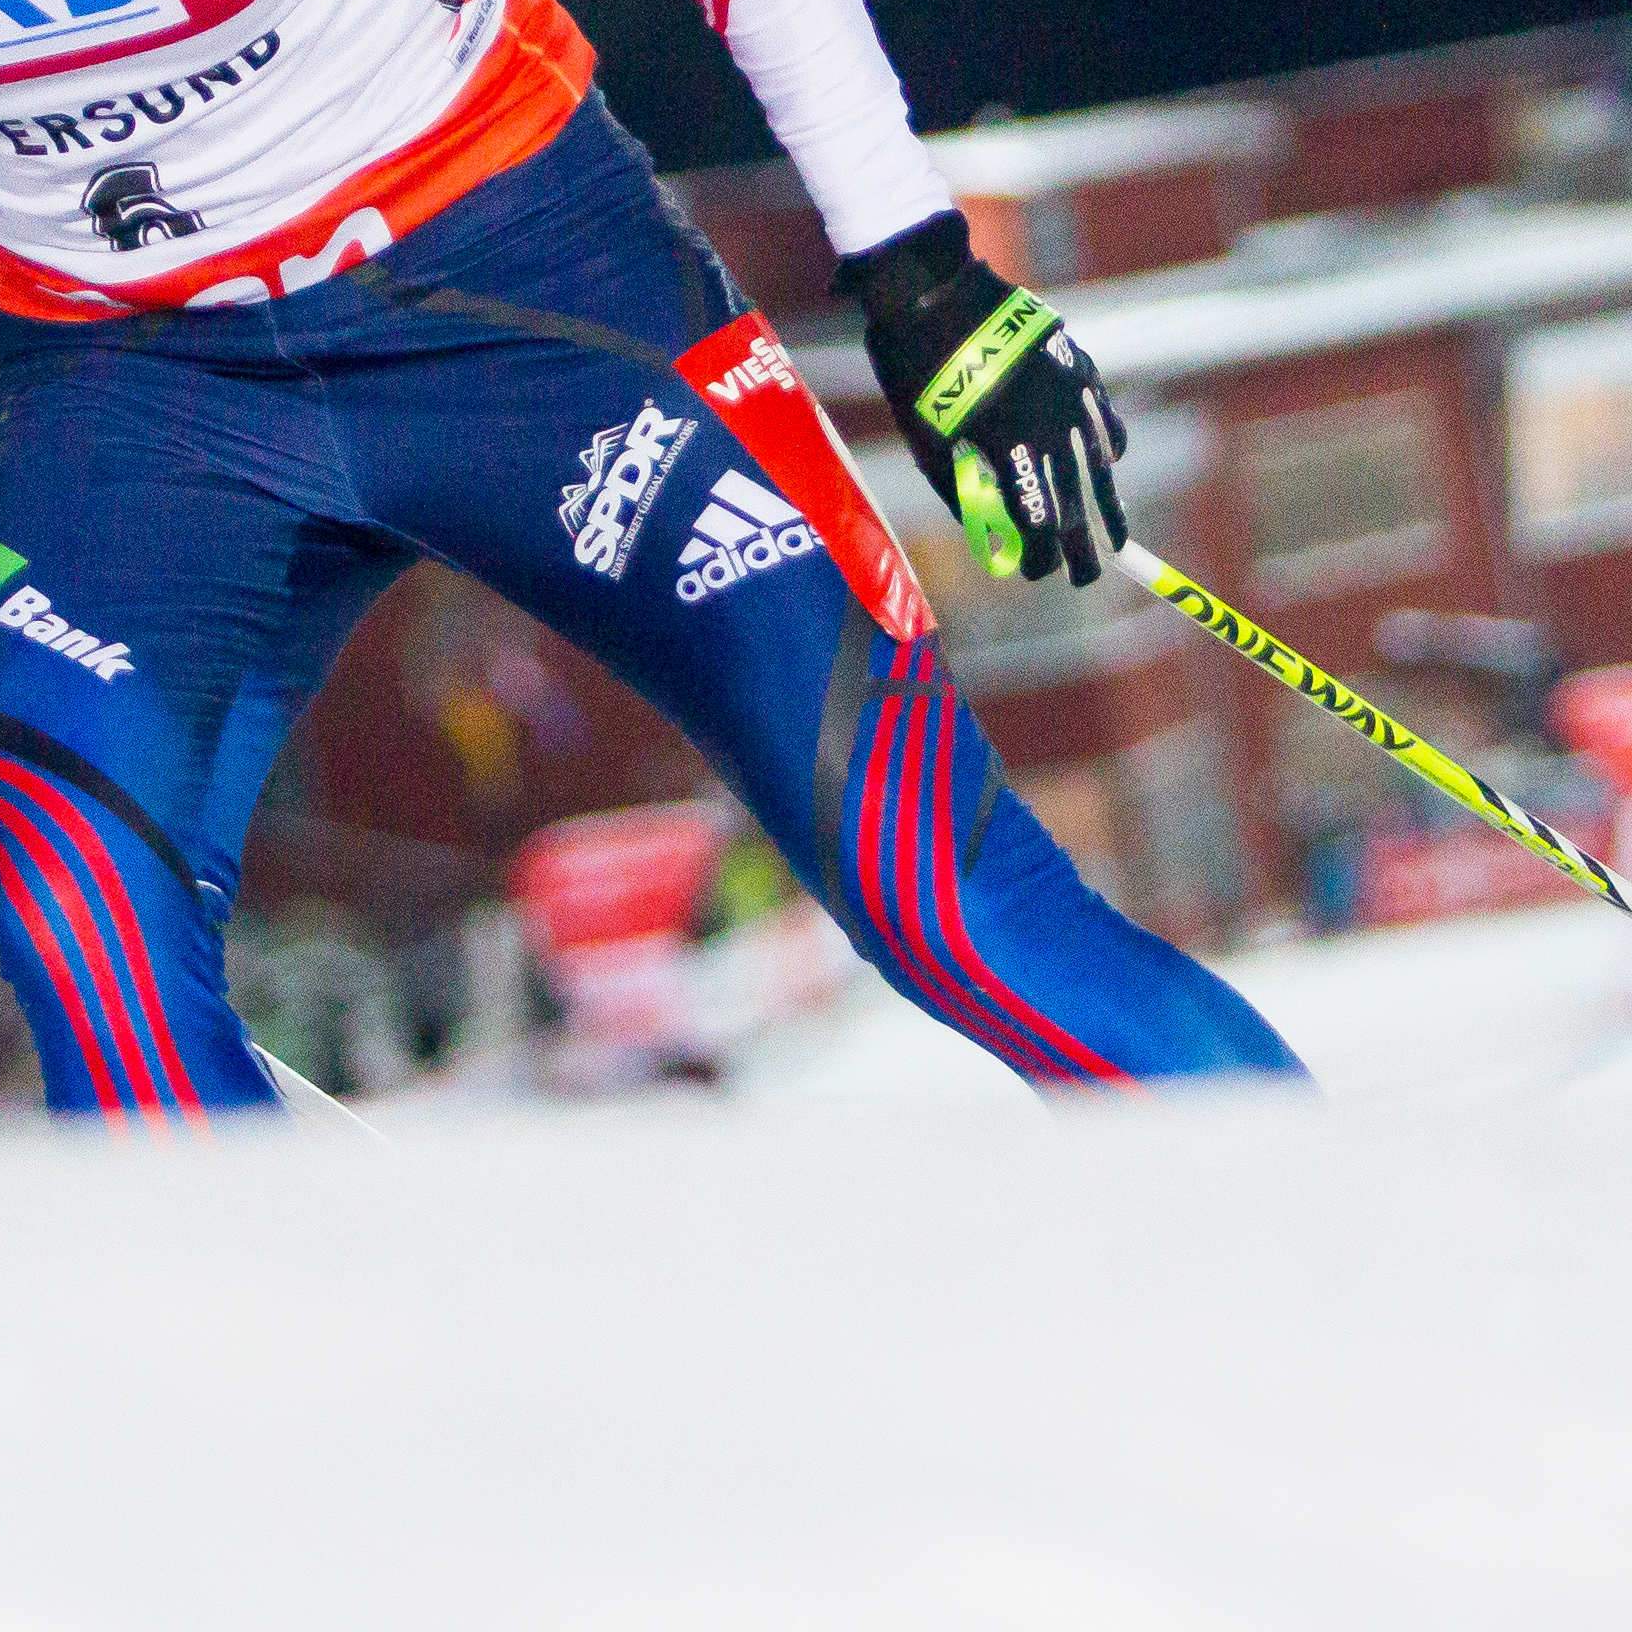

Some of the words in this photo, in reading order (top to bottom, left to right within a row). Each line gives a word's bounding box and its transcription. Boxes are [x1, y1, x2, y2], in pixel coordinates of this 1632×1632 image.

[659, 418, 699, 474] ADVISORS
[1010, 444, 1046, 523] adidas
[574, 406, 683, 572] SPDR
